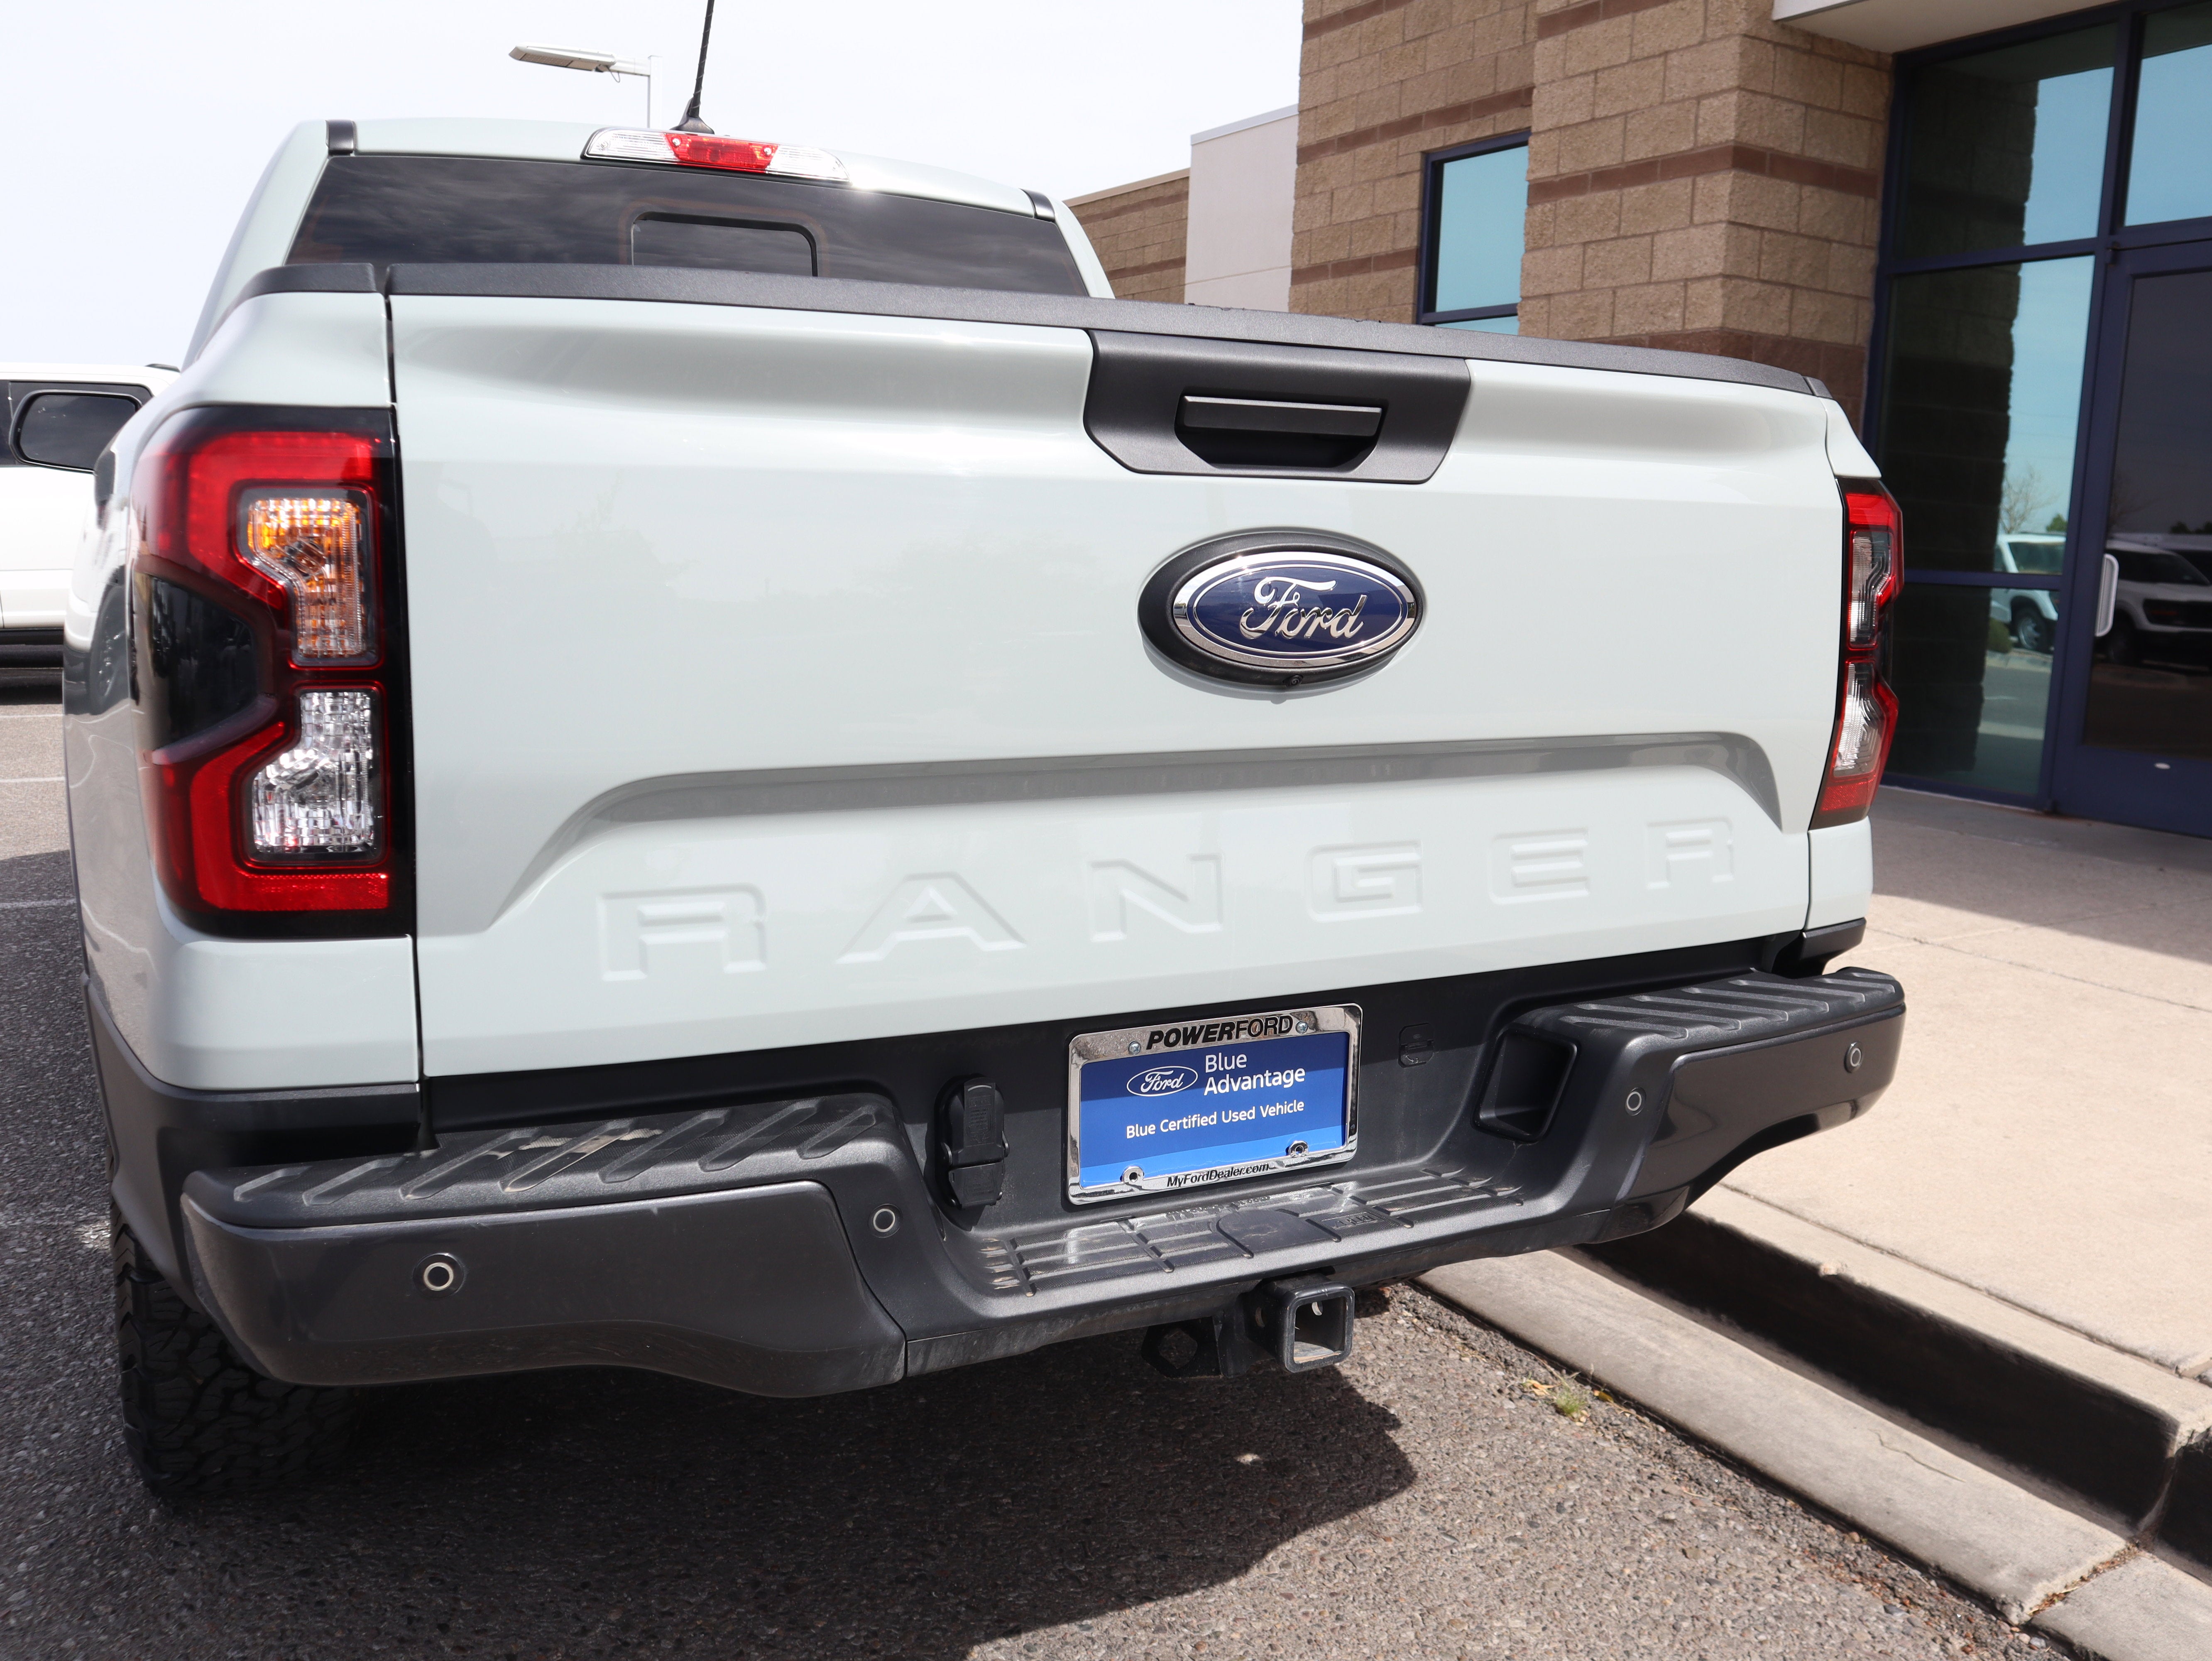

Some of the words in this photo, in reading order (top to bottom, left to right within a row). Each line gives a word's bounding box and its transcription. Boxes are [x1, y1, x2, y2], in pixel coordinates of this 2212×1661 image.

[1240, 576, 1367, 639] Ford
[596, 816, 1736, 982] RANGER
[1146, 1015, 1293, 1050] POWERFORD
[1205, 1053, 1247, 1073] Blue
[1140, 1070, 1184, 1093] Ford
[1204, 1068, 1305, 1095] Advantage
[1126, 1124, 1155, 1139] Blue
[1160, 1112, 1216, 1132] Certified
[1222, 1107, 1255, 1123] Used
[1260, 1100, 1304, 1117] Vehicle
[1167, 1163, 1269, 1188] MyFordDealer.com
